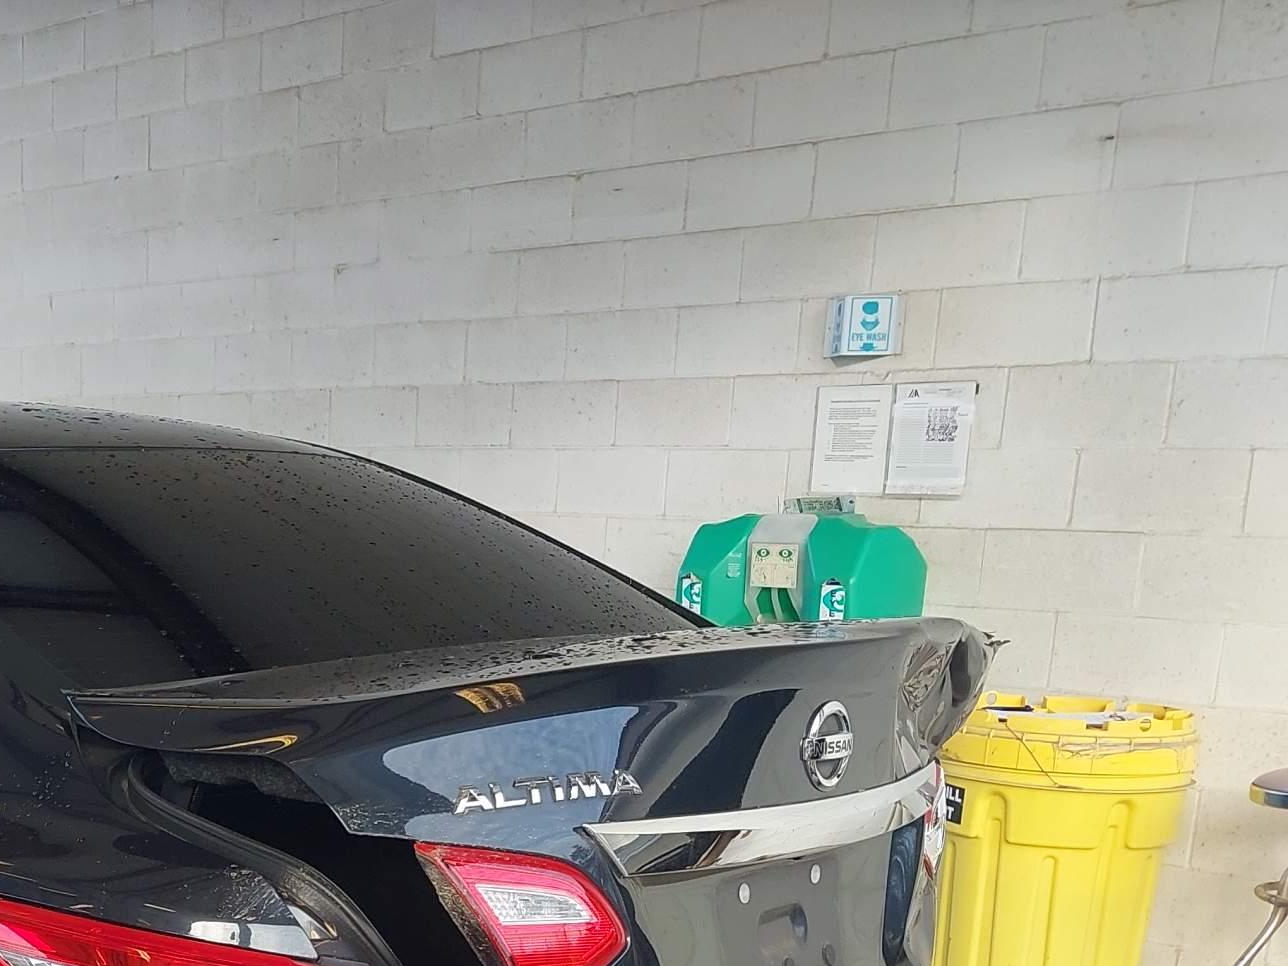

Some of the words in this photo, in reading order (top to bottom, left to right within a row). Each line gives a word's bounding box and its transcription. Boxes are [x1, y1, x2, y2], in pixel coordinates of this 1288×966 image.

[851, 332, 864, 342] EYE
[866, 332, 887, 342] WASH
[814, 739, 852, 759] NISSAN
[454, 769, 643, 815] ALTIMA
[945, 785, 962, 803] ILL
